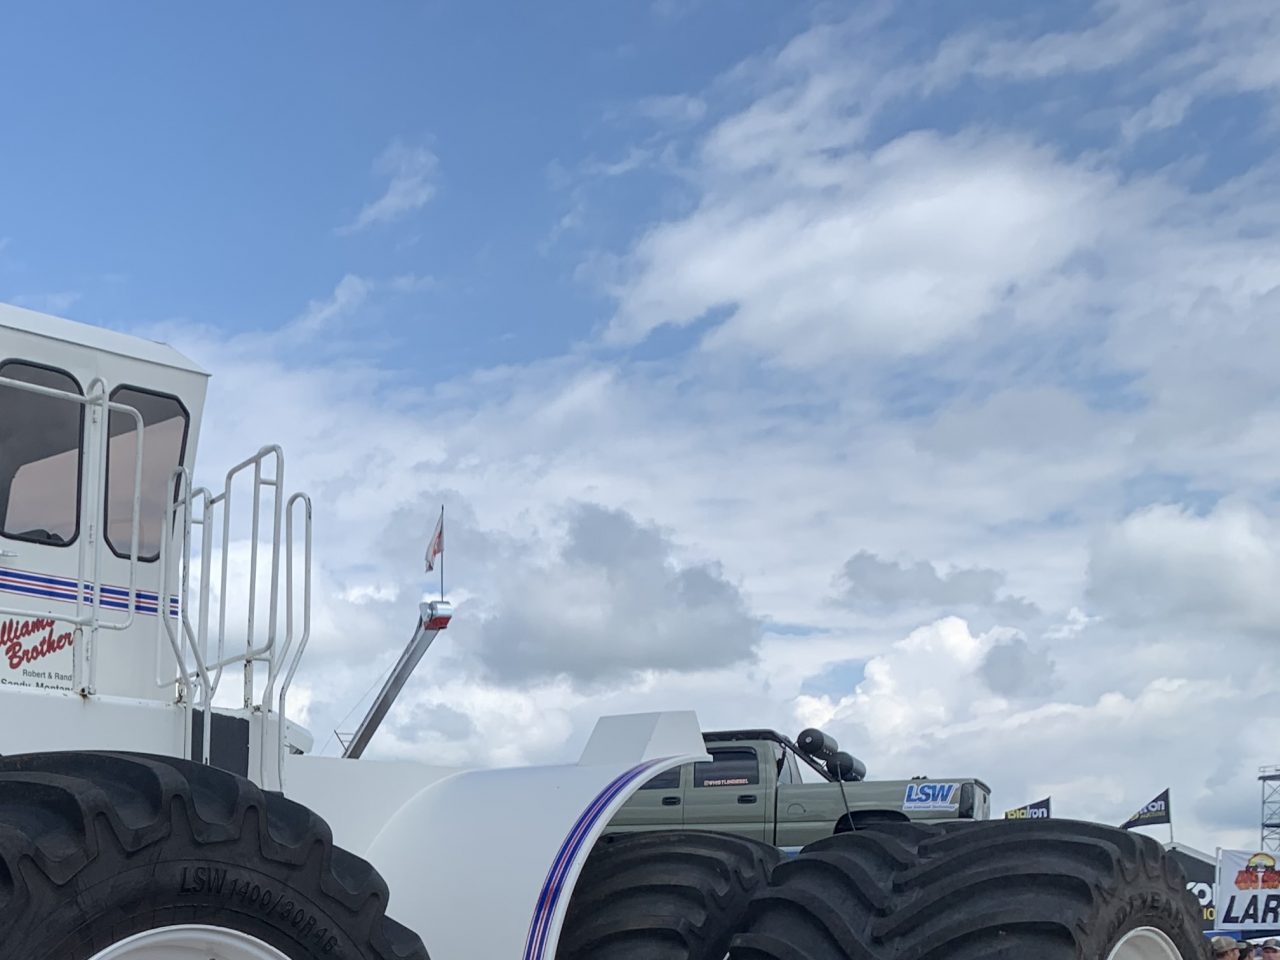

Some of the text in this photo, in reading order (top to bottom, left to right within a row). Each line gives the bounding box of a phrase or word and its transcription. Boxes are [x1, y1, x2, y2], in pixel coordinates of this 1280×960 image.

[4, 627, 74, 670] Brother
[22, 668, 73, 682] Robert & Rand
[905, 784, 954, 803] LSW
[178, 866, 227, 896] LSW
